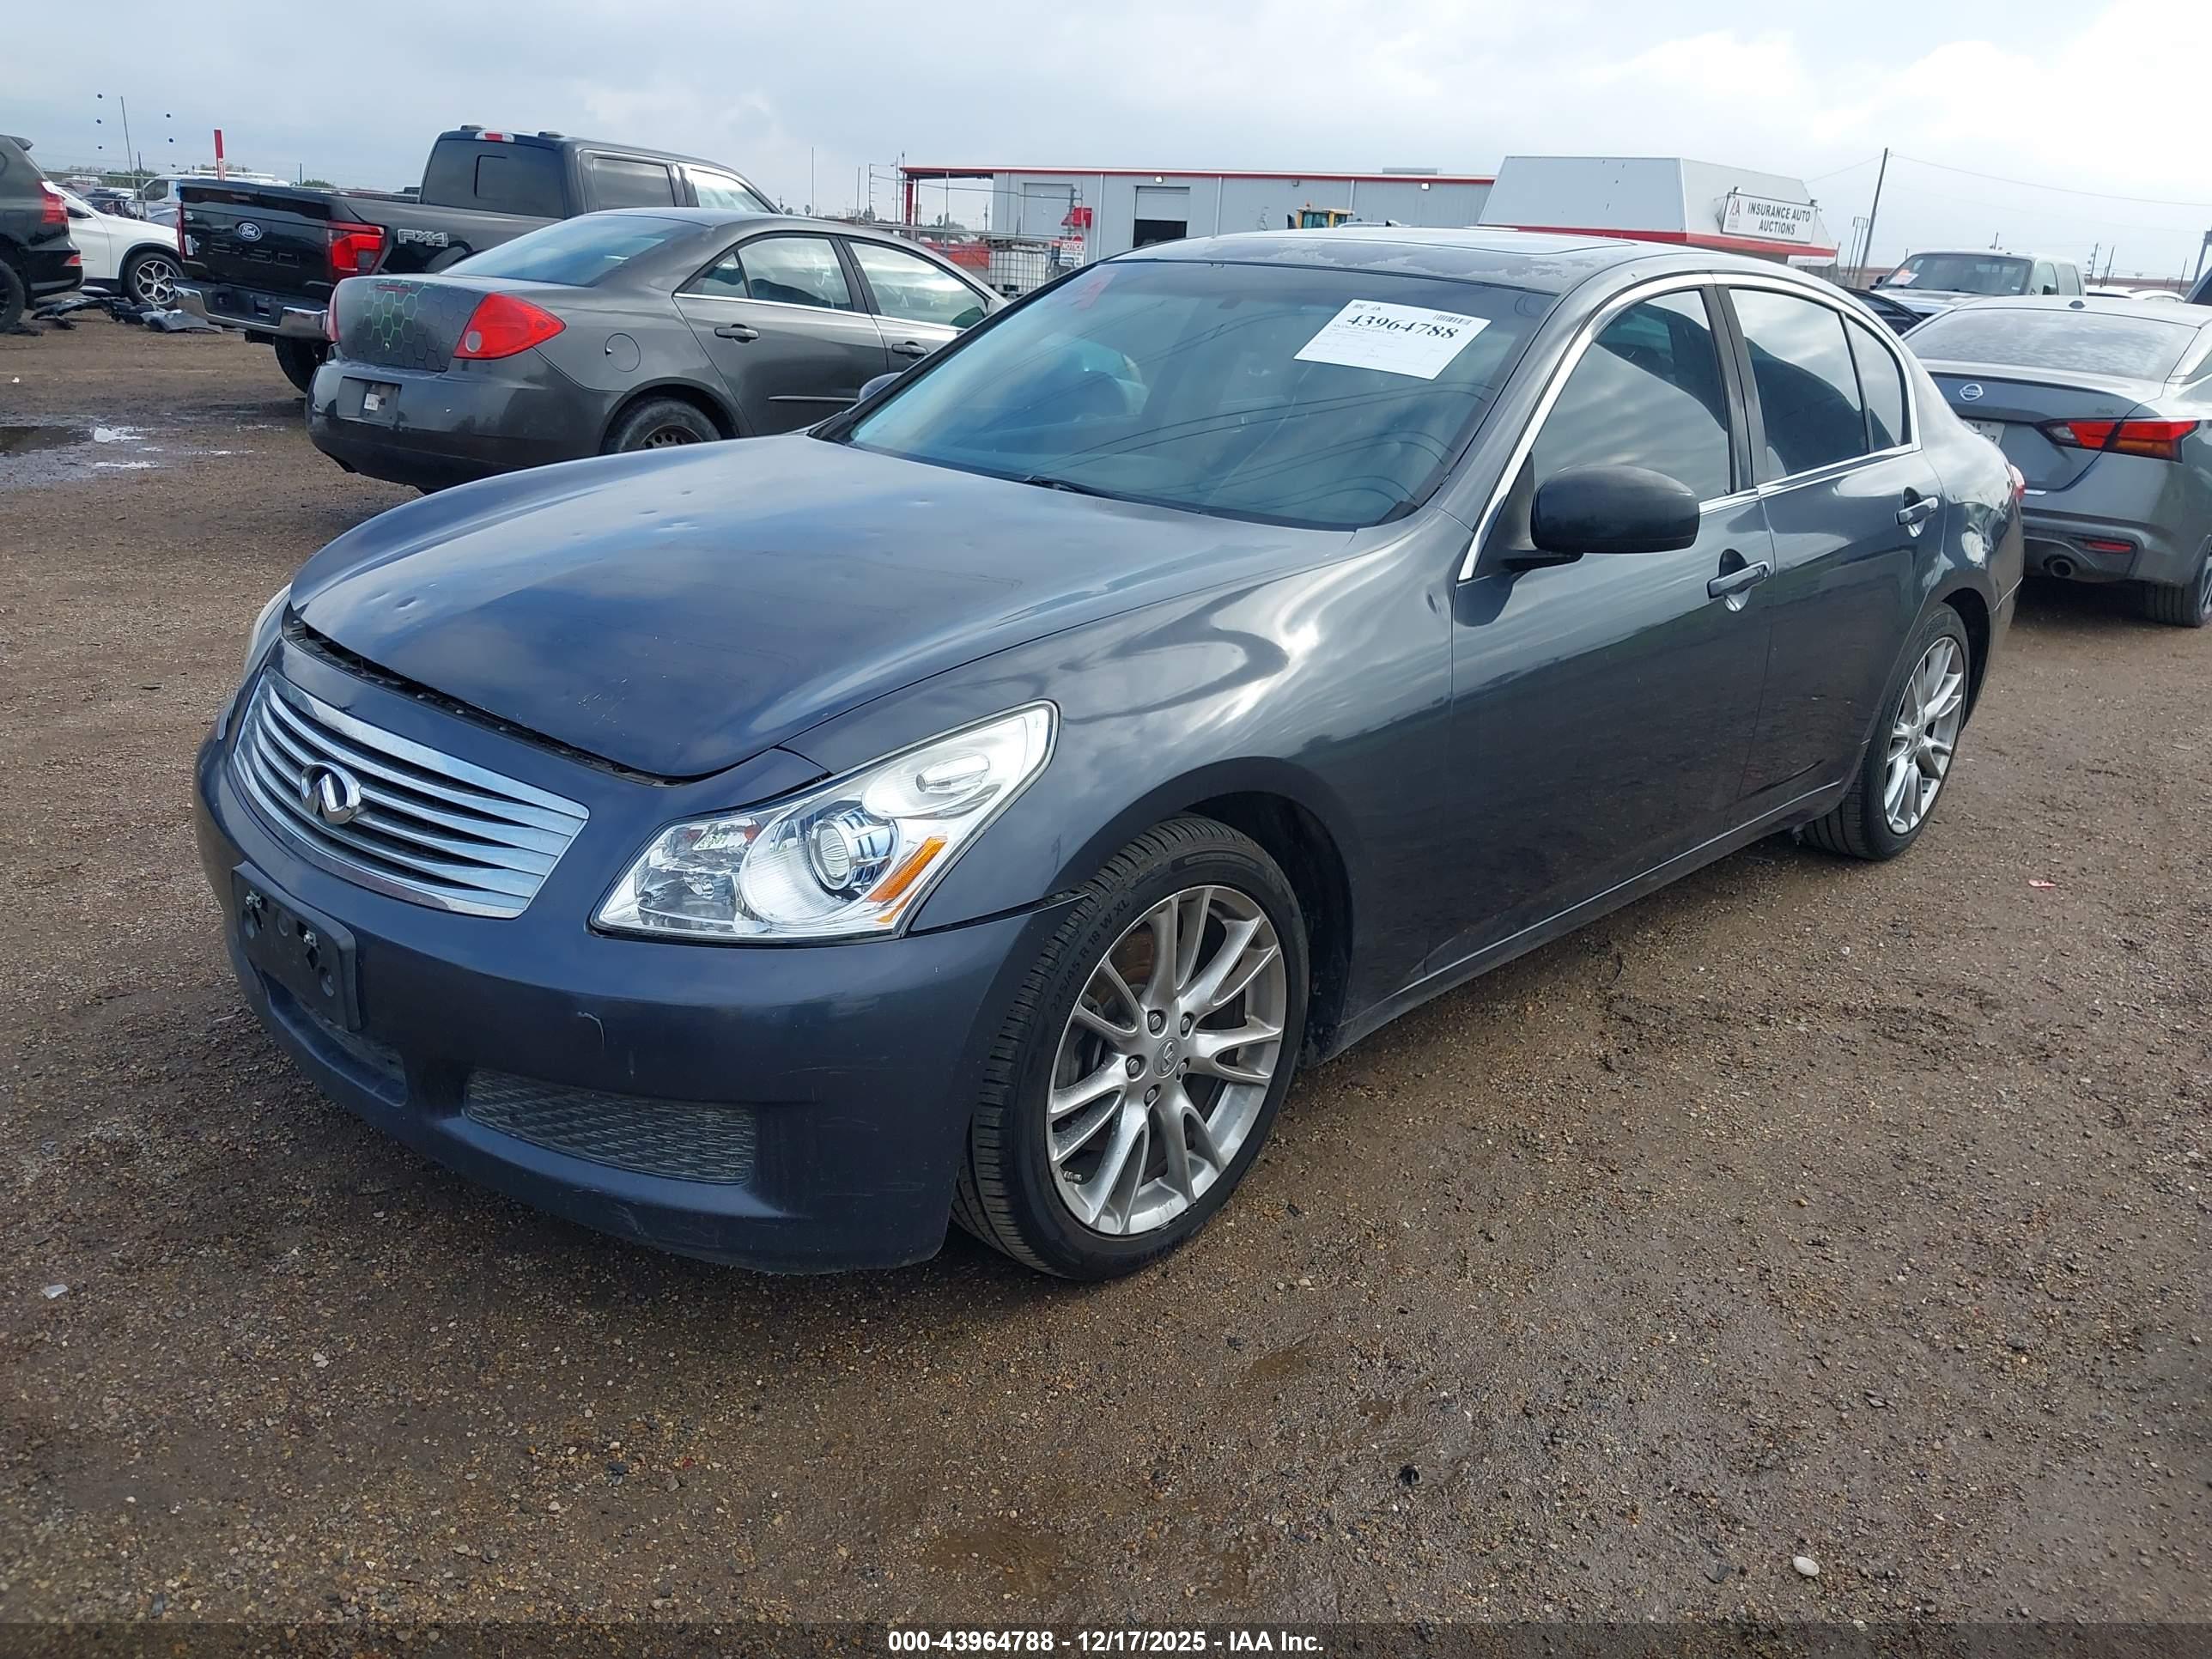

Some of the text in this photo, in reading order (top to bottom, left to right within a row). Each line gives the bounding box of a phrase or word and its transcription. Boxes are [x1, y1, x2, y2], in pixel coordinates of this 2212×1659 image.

[1747, 202, 1811, 223] INSURANCE AUTO
[241, 224, 257, 237] Ford
[398, 228, 449, 247] FX4
[1759, 219, 1796, 236] AUCTIONS
[1346, 314, 1459, 338] 43964788
[1050, 900, 1131, 1011] 225/45 R 18 W XL
